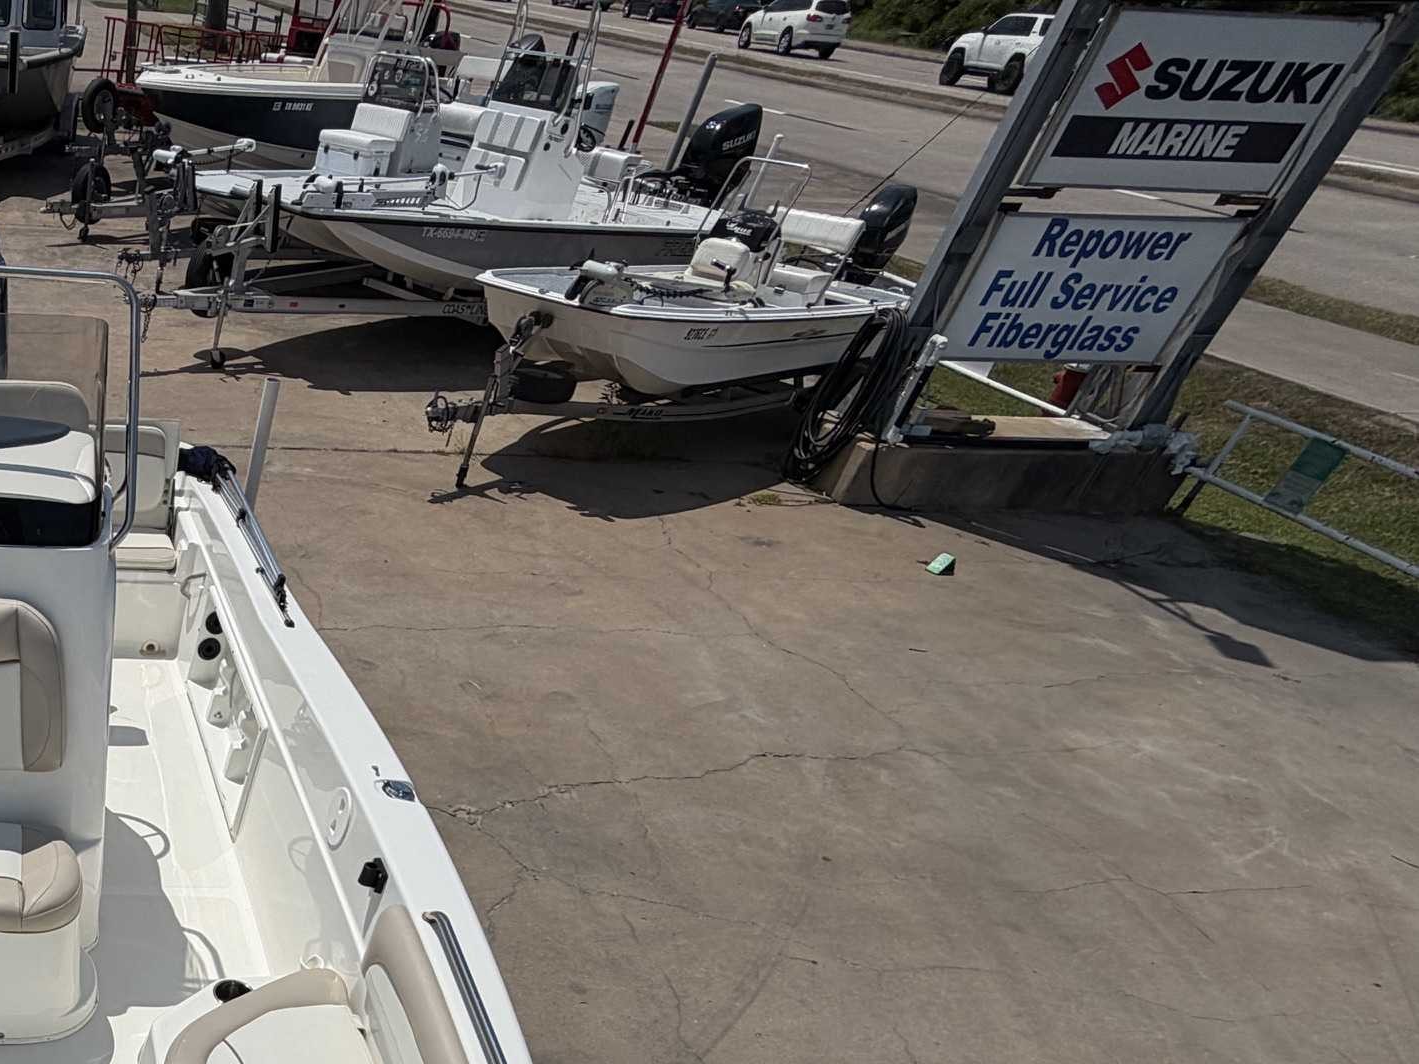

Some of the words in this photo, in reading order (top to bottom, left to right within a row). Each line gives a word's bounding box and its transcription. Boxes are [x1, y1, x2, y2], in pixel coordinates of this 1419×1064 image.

[1144, 57, 1346, 105] SUZUKI
[1107, 121, 1250, 159] MARINE
[1031, 217, 1193, 268] Repower
[979, 269, 1054, 309] Full
[1050, 272, 1179, 314] Service
[968, 312, 1141, 360] Fiberglass
